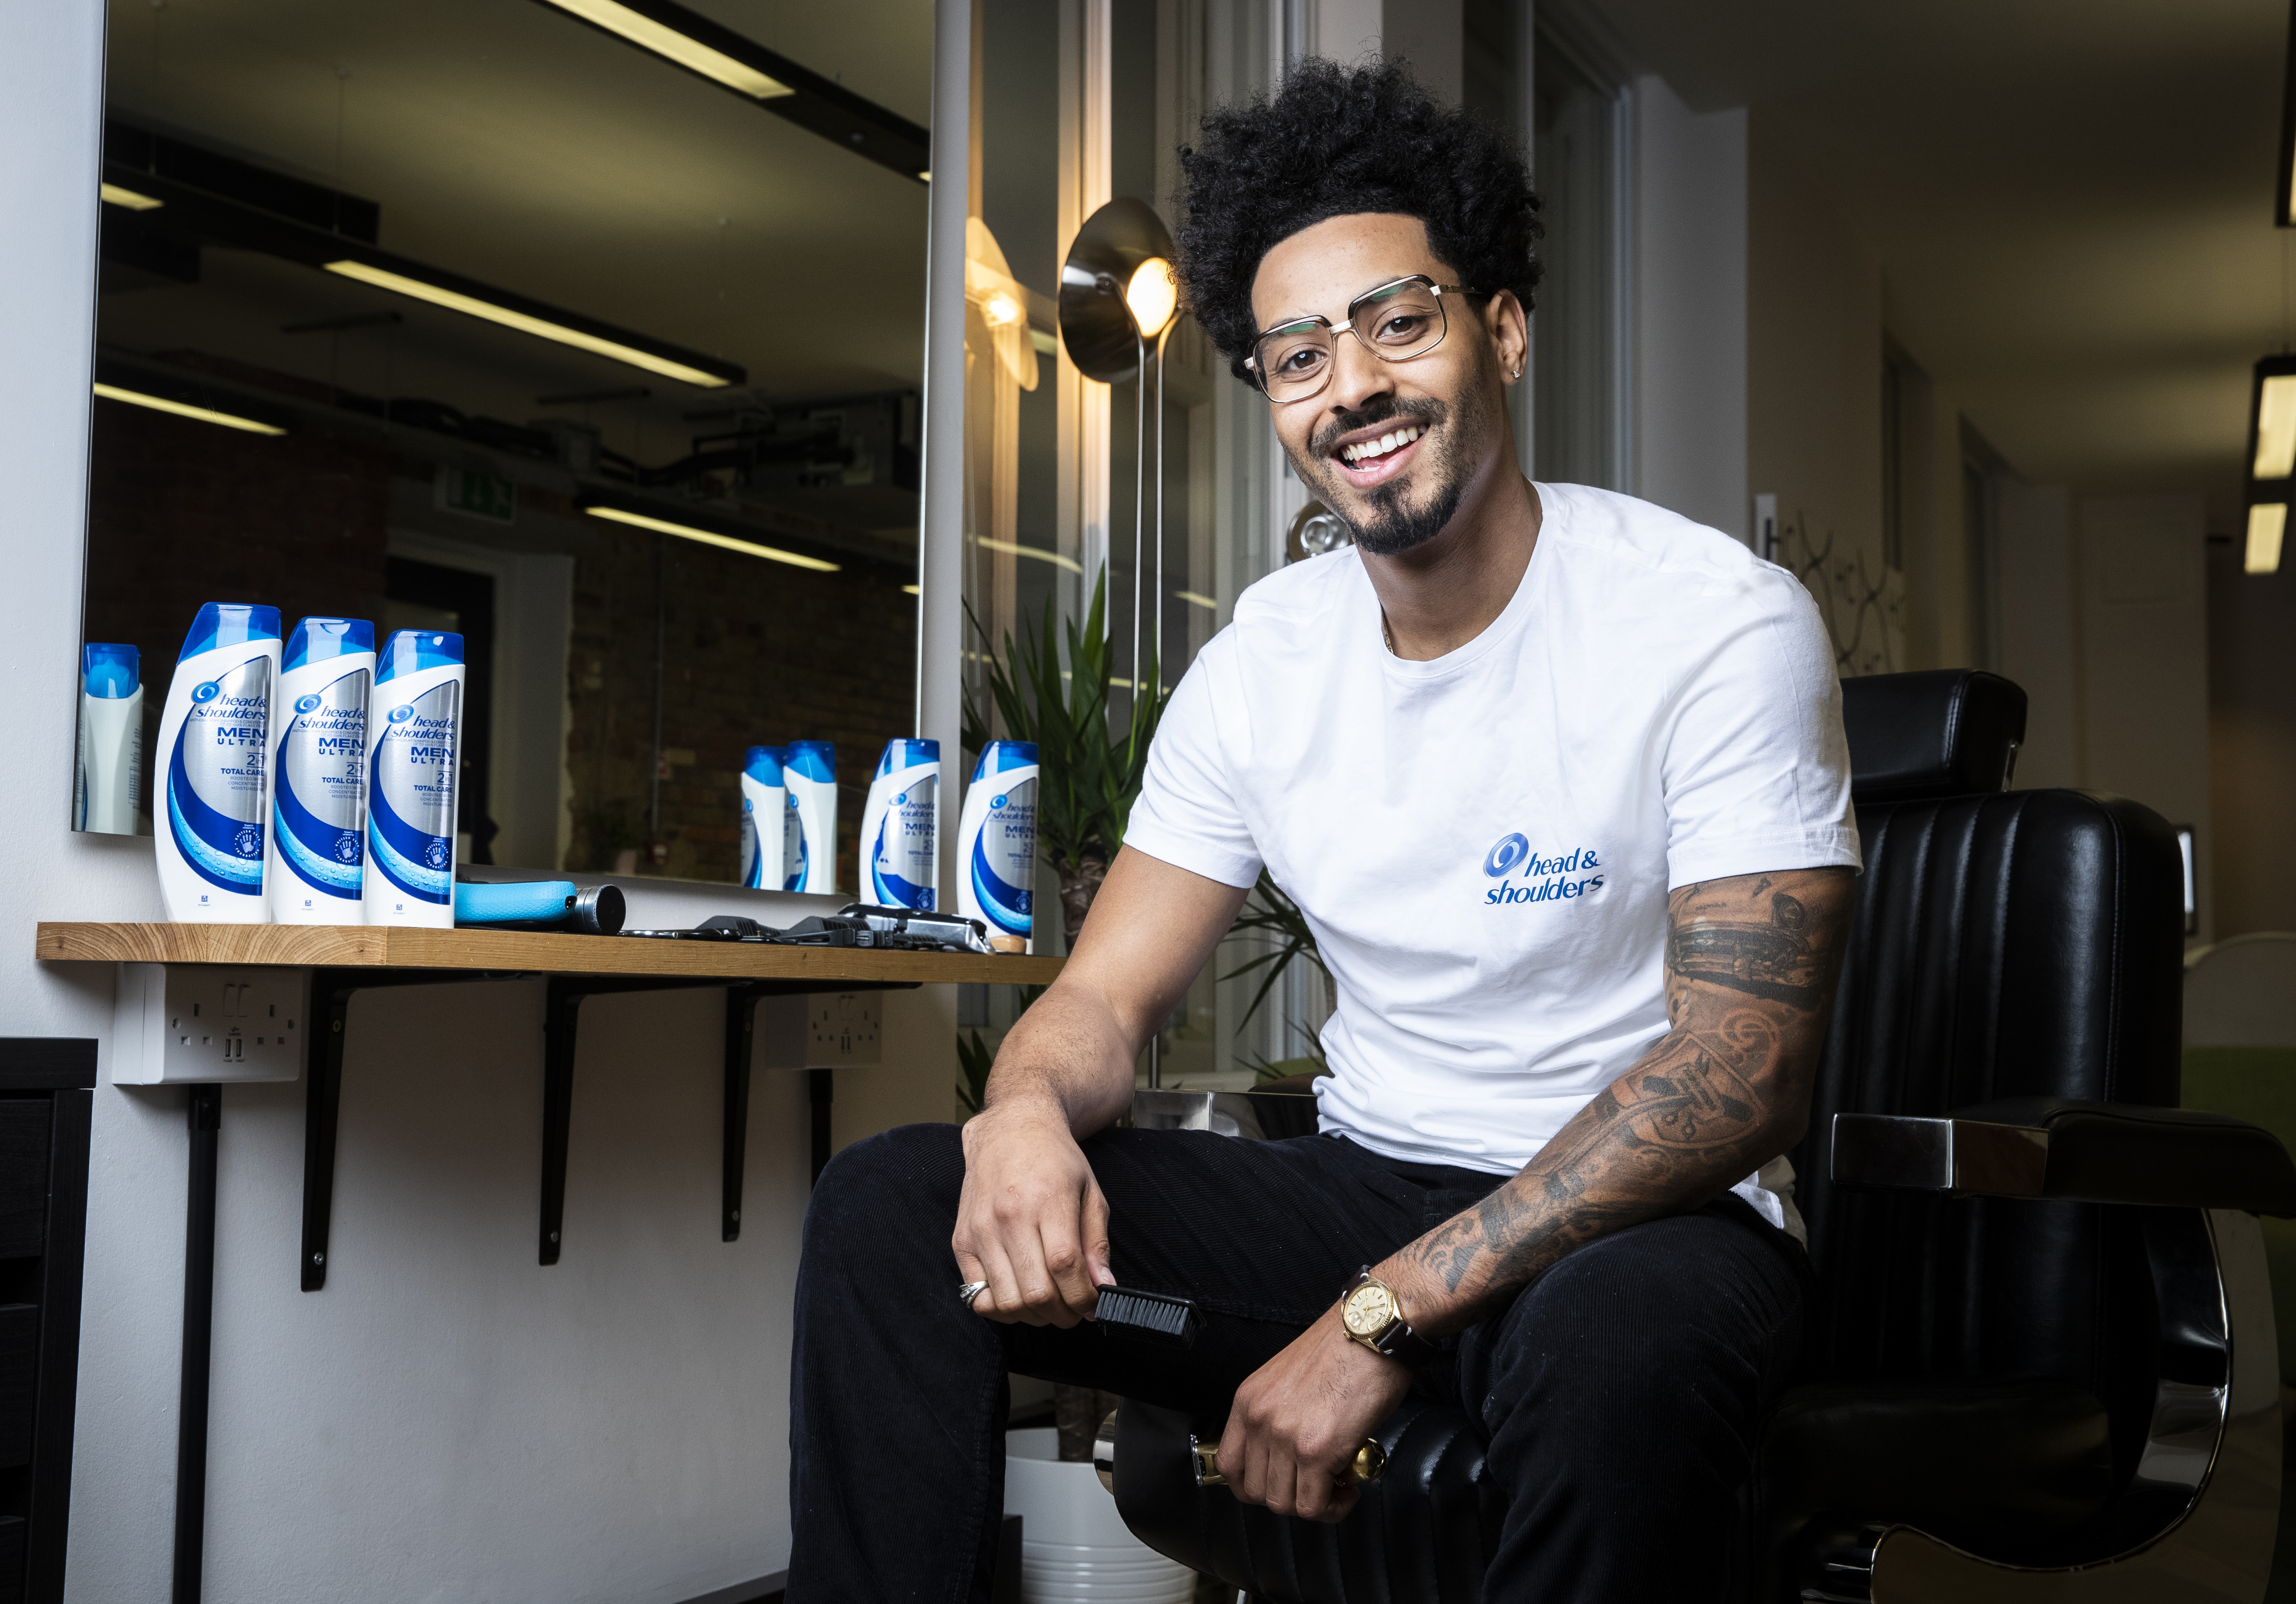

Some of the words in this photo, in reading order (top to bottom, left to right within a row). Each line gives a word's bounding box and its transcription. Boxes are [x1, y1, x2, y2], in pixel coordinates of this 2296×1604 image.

[196, 706, 266, 720] shoulders
[298, 717, 365, 731] shoulders
[218, 727, 266, 739] MEN
[391, 726, 455, 740] shoulders
[218, 738, 266, 747] ULTRA
[319, 738, 364, 749] MEN
[319, 748, 364, 757] ULTRA
[411, 746, 454, 758] MEN
[411, 757, 454, 766] ULTRA
[905, 823, 934, 831] MEN
[1005, 825, 1035, 834] MEN
[1484, 874, 1604, 905] shoulders
